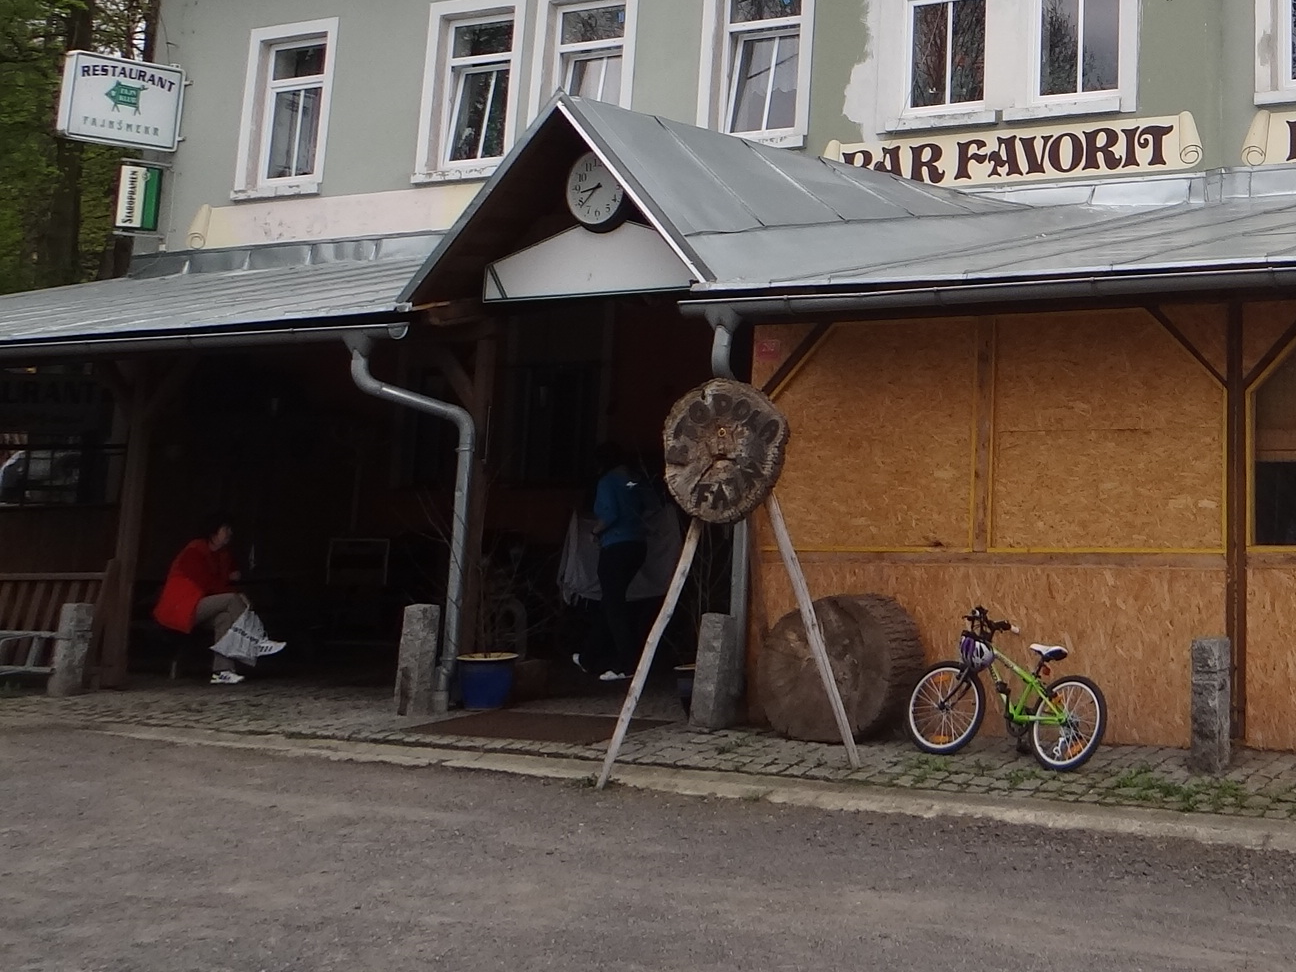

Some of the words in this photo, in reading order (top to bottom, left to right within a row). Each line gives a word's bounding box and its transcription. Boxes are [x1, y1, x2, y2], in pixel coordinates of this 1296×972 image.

[81, 64, 176, 92] RESTAURANT
[954, 124, 1174, 180] FAVORIT
[578, 173, 587, 183] 10
